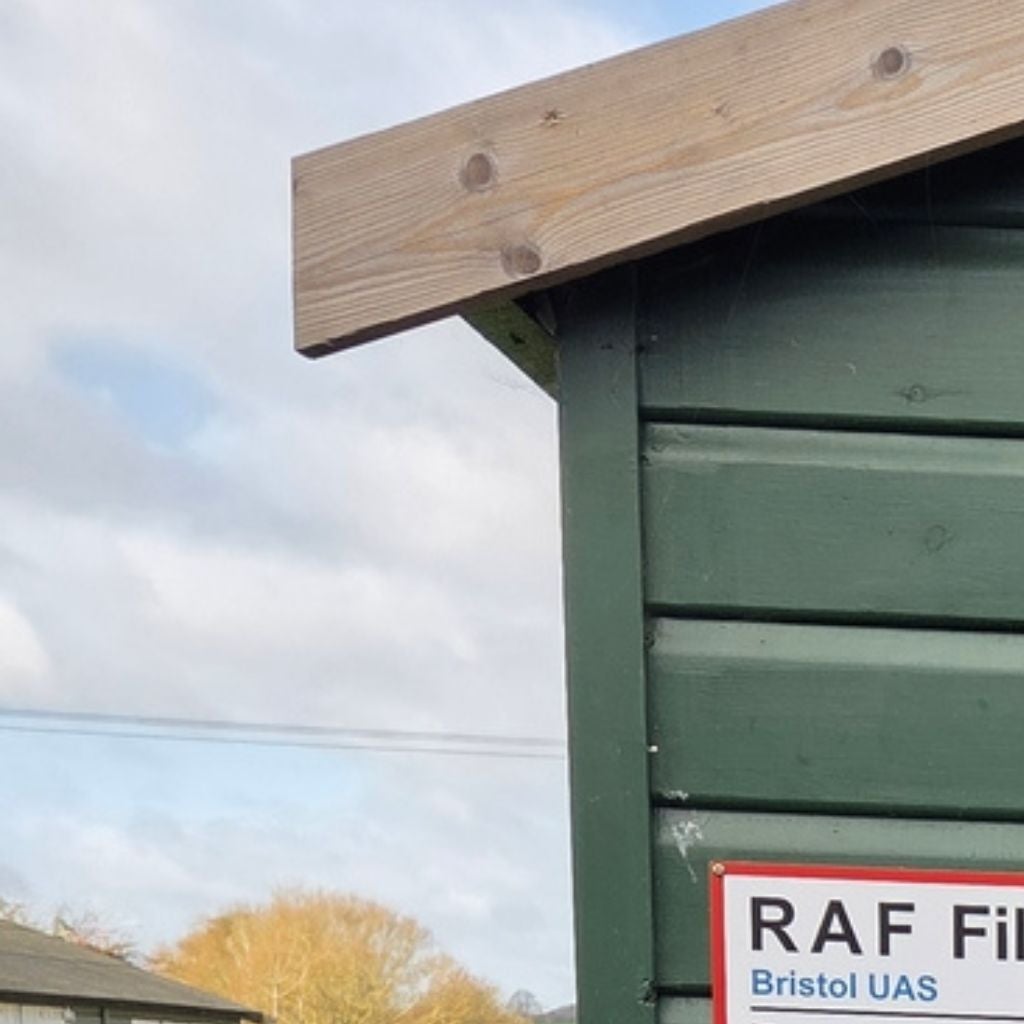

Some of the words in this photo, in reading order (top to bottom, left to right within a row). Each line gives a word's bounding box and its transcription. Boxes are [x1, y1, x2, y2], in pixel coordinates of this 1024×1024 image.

[750, 895, 916, 957] RAF
[751, 968, 857, 999] Bristol
[868, 973, 938, 1002] UAS
